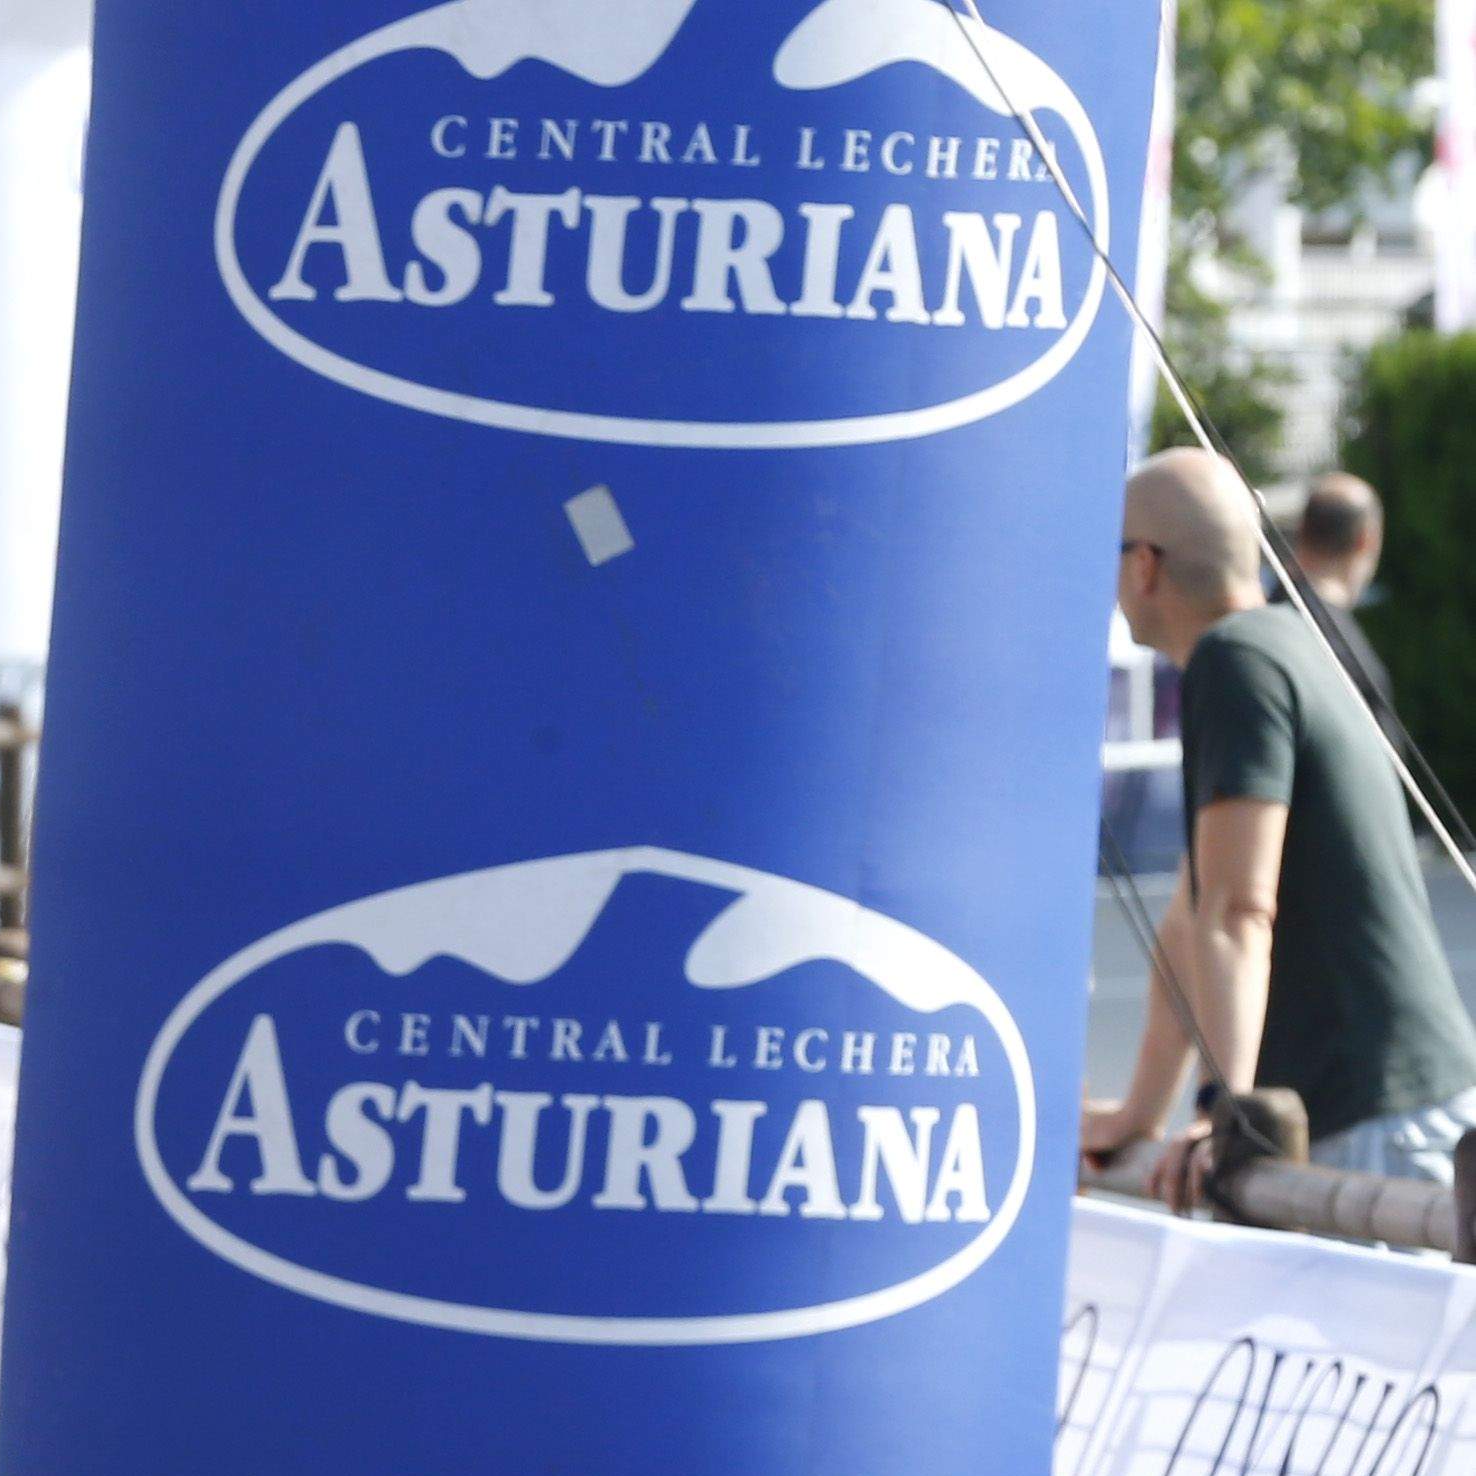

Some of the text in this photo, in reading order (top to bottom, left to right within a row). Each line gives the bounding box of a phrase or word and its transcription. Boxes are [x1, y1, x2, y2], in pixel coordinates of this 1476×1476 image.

[430, 114, 762, 166] CENTRAL
[268, 120, 1067, 330] ASTURIANA
[344, 1009, 981, 1077] CENTRAL LECHERA
[188, 1012, 991, 1224] ASTURIANA
